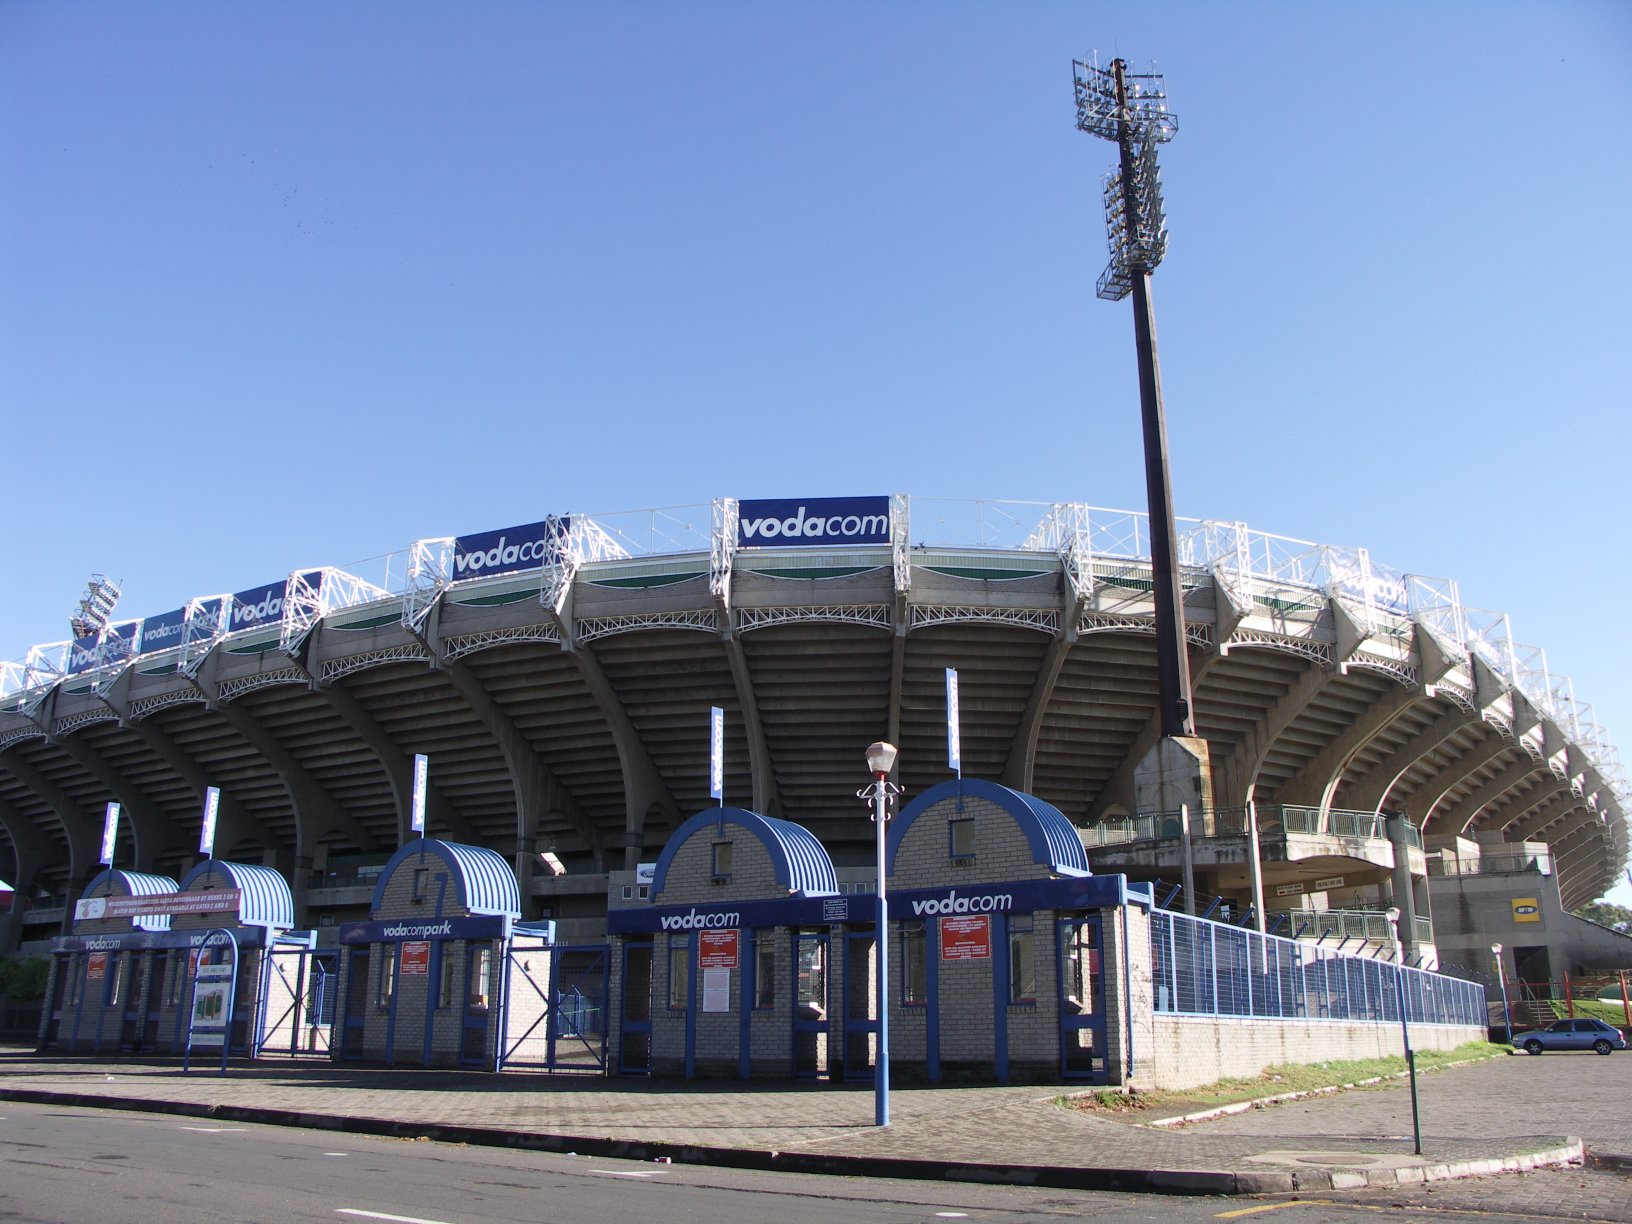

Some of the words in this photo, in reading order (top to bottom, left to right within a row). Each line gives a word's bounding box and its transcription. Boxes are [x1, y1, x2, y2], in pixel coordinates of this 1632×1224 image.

[740, 506, 888, 539] vodacom
[234, 587, 320, 624] voda
[948, 676, 959, 761] vodacom
[712, 714, 722, 792] vodacom
[912, 890, 1013, 916] vodacom
[383, 920, 452, 939] vodacompark
[660, 908, 740, 930] vodacom
[85, 934, 121, 950] vodacom
